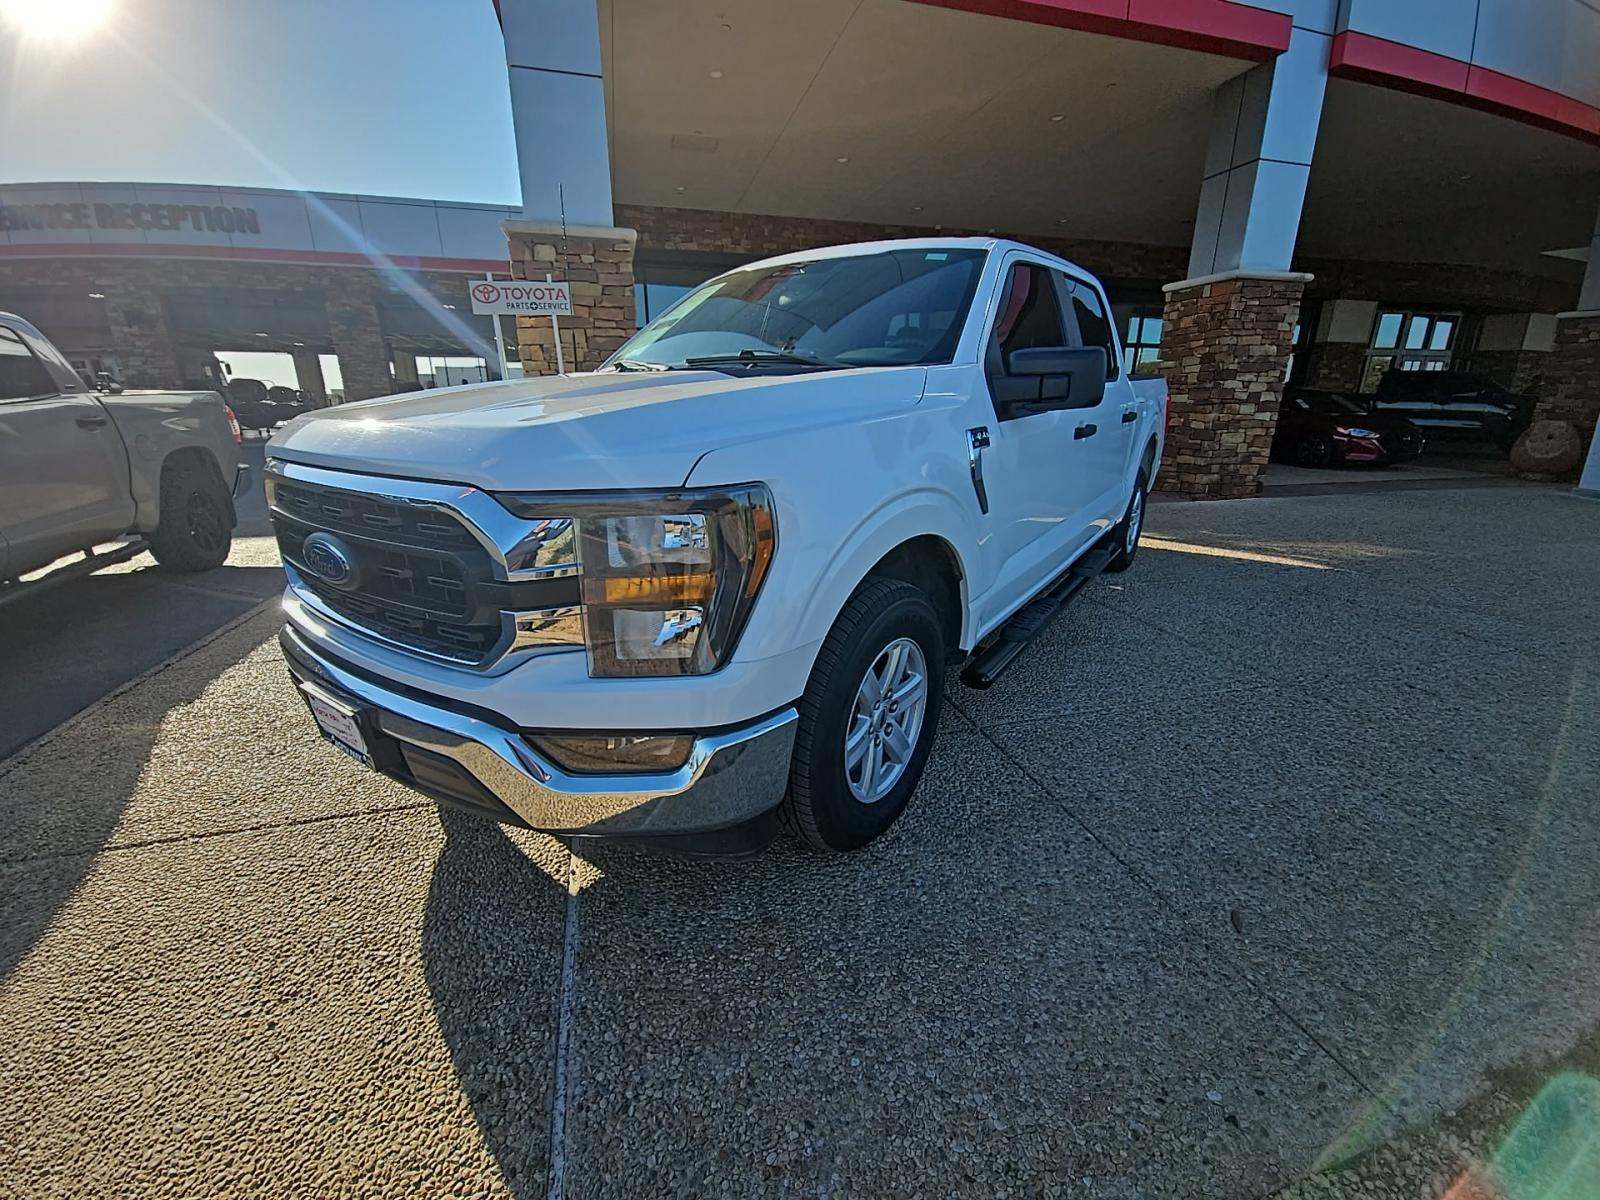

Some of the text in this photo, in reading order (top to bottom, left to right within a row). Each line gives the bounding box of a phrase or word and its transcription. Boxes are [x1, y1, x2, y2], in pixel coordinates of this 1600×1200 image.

[94, 203, 261, 234] RECEPTION
[501, 287, 567, 300] TOYOTA
[506, 302, 569, 310] PARTS SERVICE
